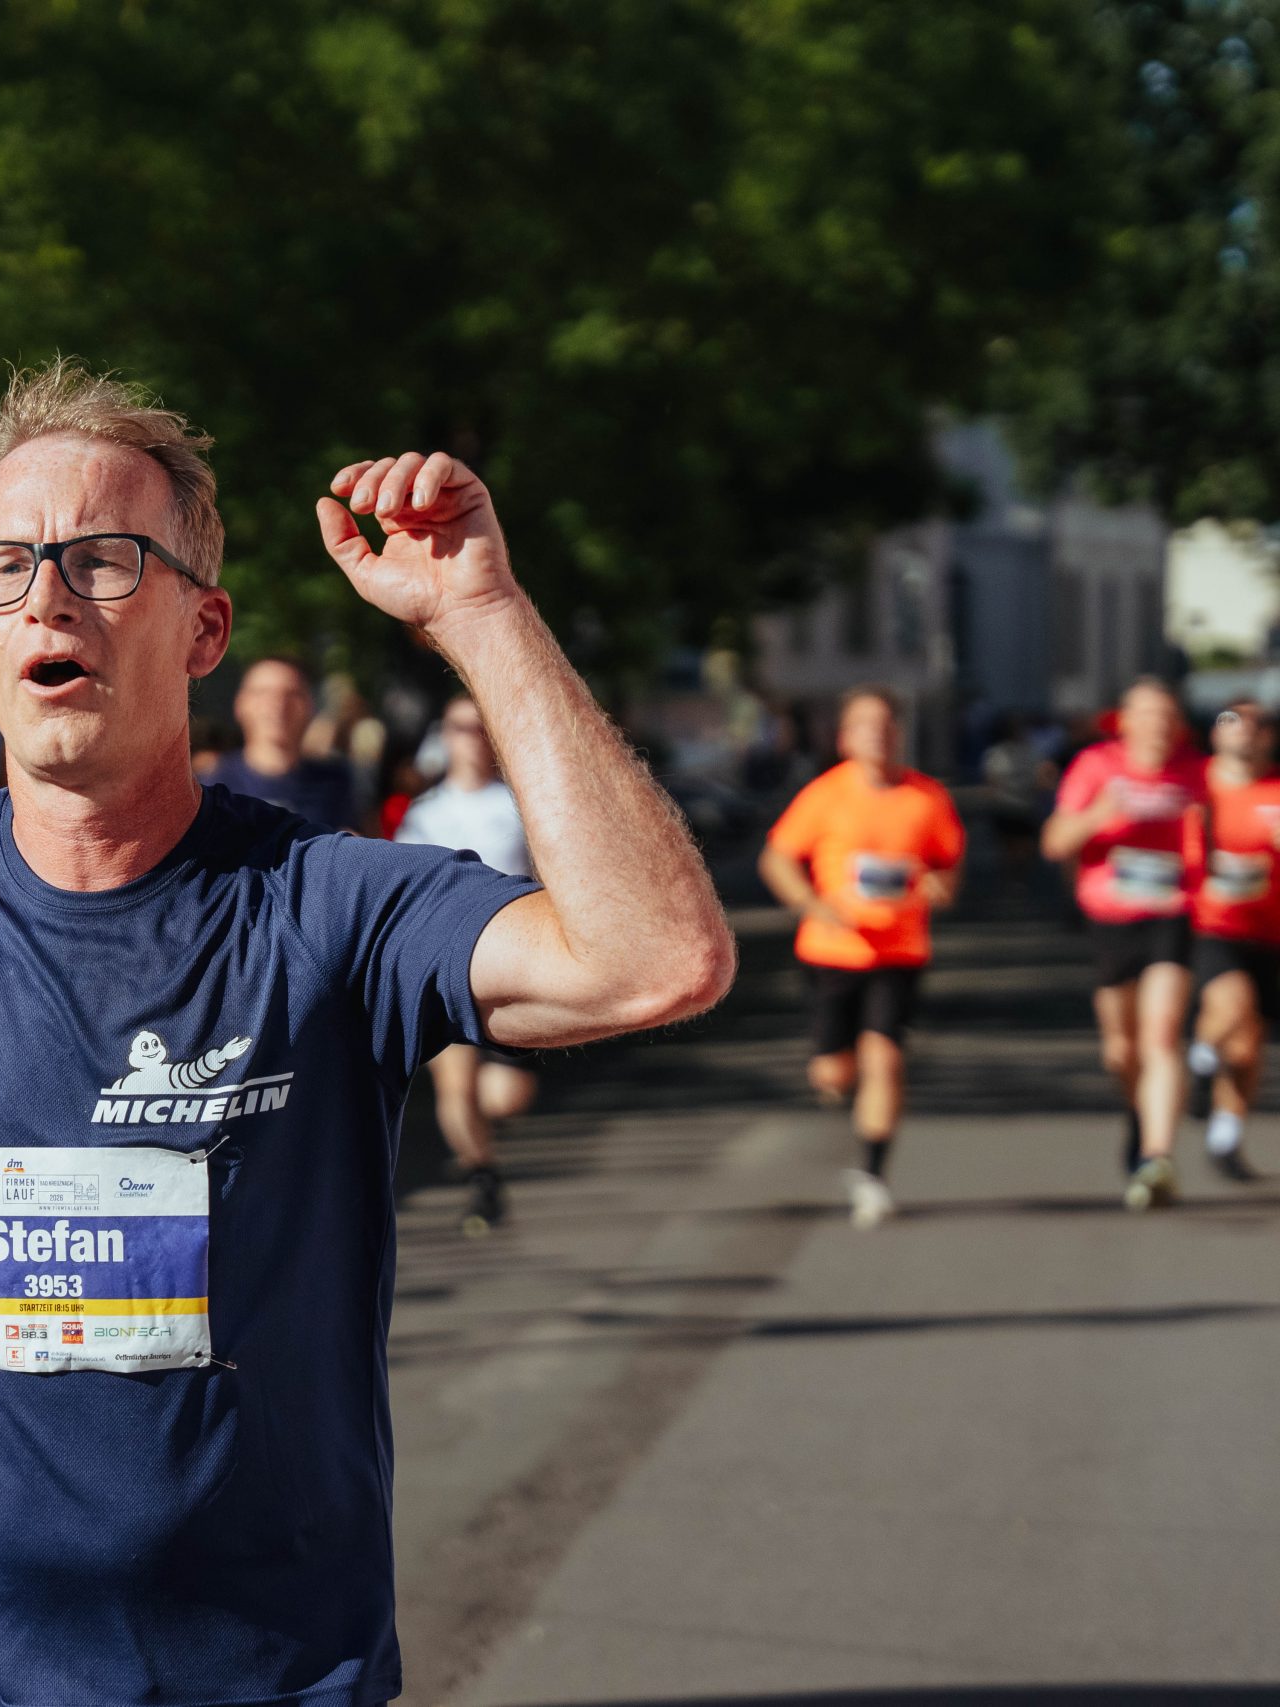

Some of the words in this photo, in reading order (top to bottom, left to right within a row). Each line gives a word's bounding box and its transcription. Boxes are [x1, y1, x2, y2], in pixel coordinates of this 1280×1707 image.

[91, 1084, 291, 1124] MICHELIN
[7, 1158, 23, 1168] dm
[6, 1178, 35, 1187] FIRMEN
[6, 1188, 35, 1200] LAUF
[24, 1274, 83, 1298] 3953
[19, 1303, 53, 1312] STARTZEIT
[54, 1303, 70, 1312] 18:15
[70, 1303, 85, 1312] UHR
[21, 1331, 48, 1339] 88.3
[94, 1326, 172, 1337] BIONTECH
